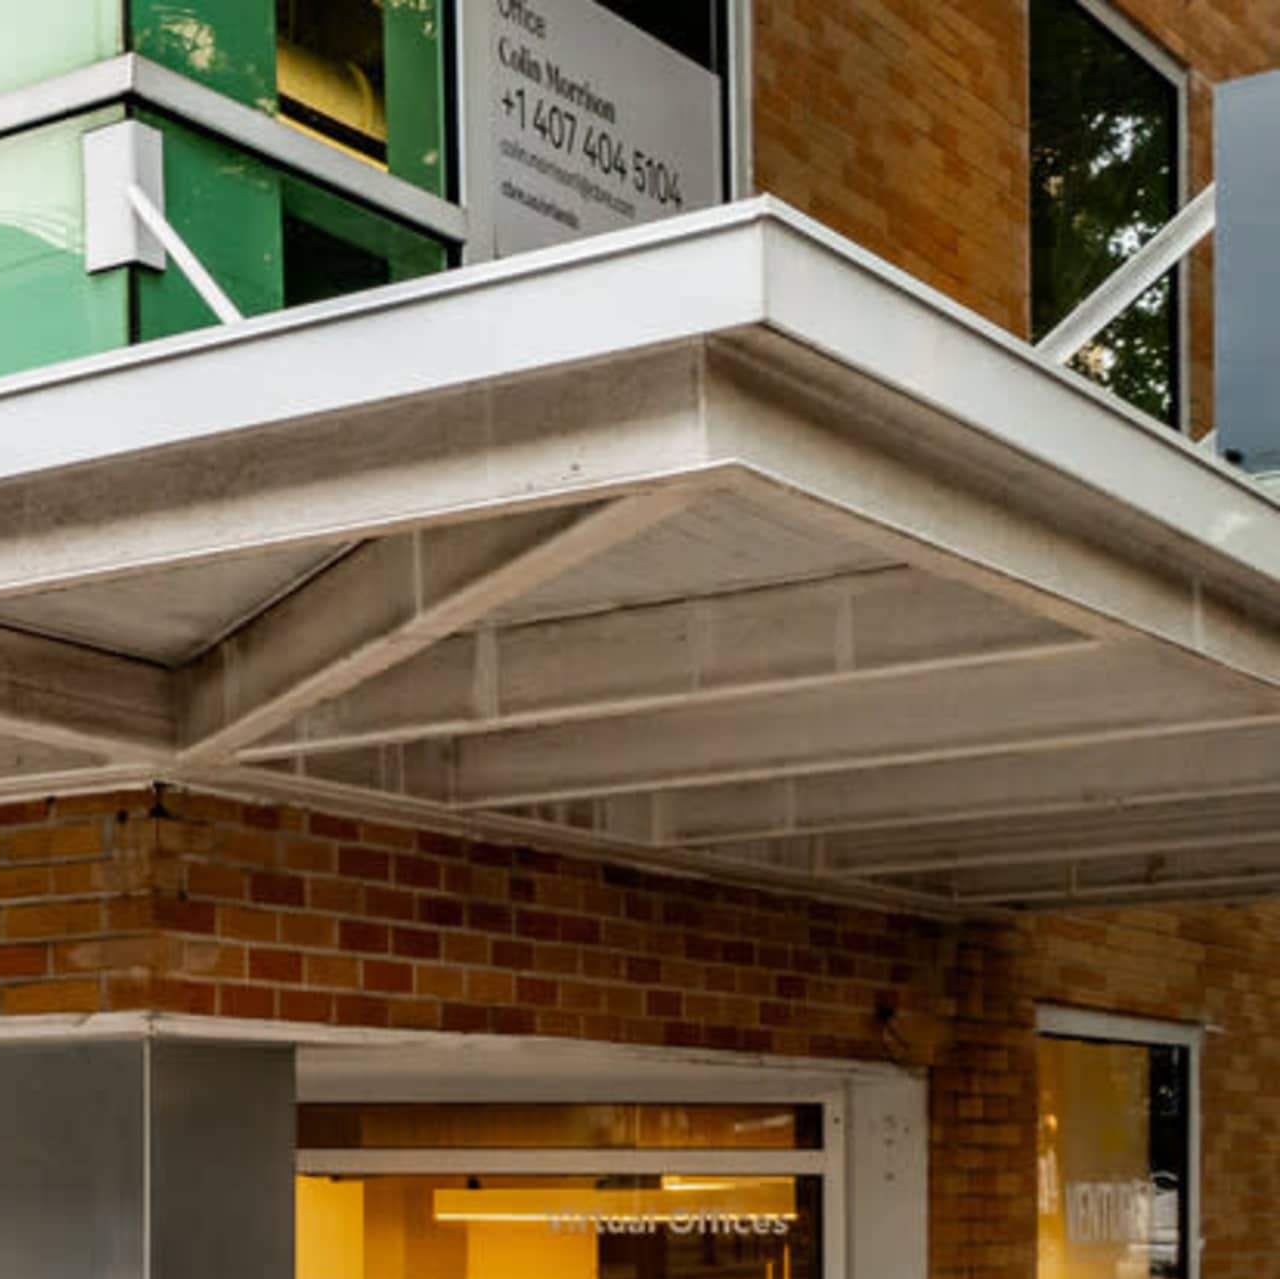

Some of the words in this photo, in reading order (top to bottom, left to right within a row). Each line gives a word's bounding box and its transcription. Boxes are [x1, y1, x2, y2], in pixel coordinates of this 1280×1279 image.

[502, 88, 526, 131] +1
[533, 98, 577, 156] 407
[582, 124, 628, 184] 404
[633, 149, 683, 209] 5104
[668, 1207, 789, 1234] Offices
